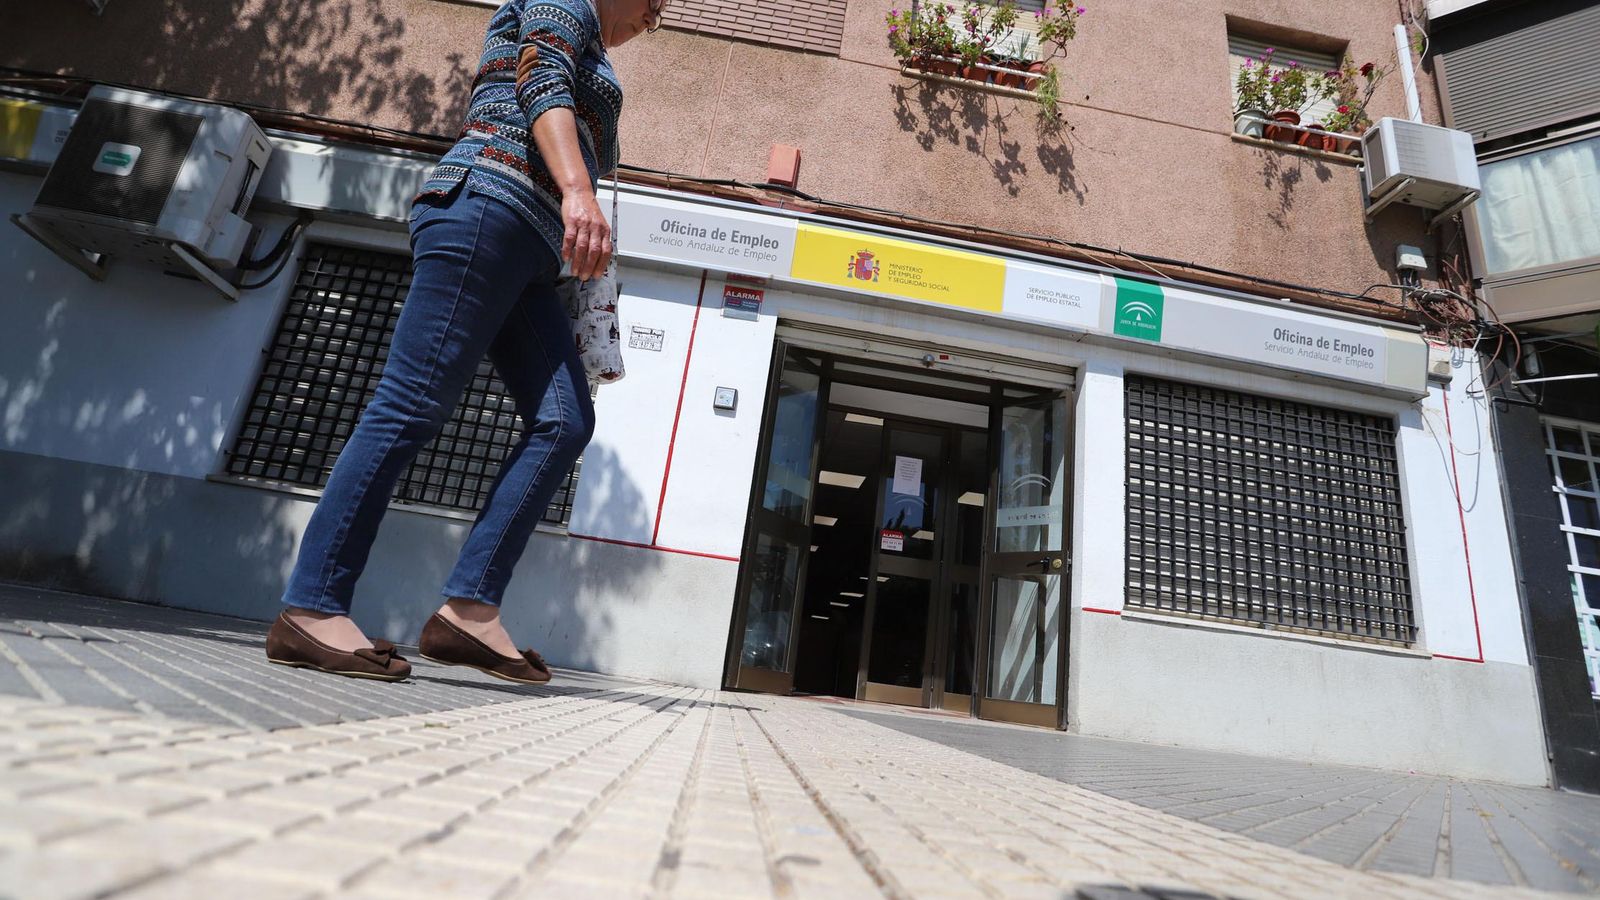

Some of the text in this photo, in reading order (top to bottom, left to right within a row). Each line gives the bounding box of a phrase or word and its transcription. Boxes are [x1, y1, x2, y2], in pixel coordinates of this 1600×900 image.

[660, 219, 779, 249] Oficina de Empleo
[648, 233, 777, 261] Servicio Andaluz de Empleo
[889, 263, 923, 274] MINISTERIO
[898, 271, 921, 280] EMPLEO
[893, 277, 927, 287] SEGURIDAD
[929, 283, 950, 292] SOCIAL
[725, 290, 760, 301] ALARMA
[1028, 287, 1054, 297] SERVICIO
[1035, 295, 1058, 303] EMPLEO
[1059, 298, 1081, 308] ESTATAL
[1273, 328, 1374, 358] Oficina de Empleo
[1264, 341, 1374, 369] Servicio Andaluz de Empleo
